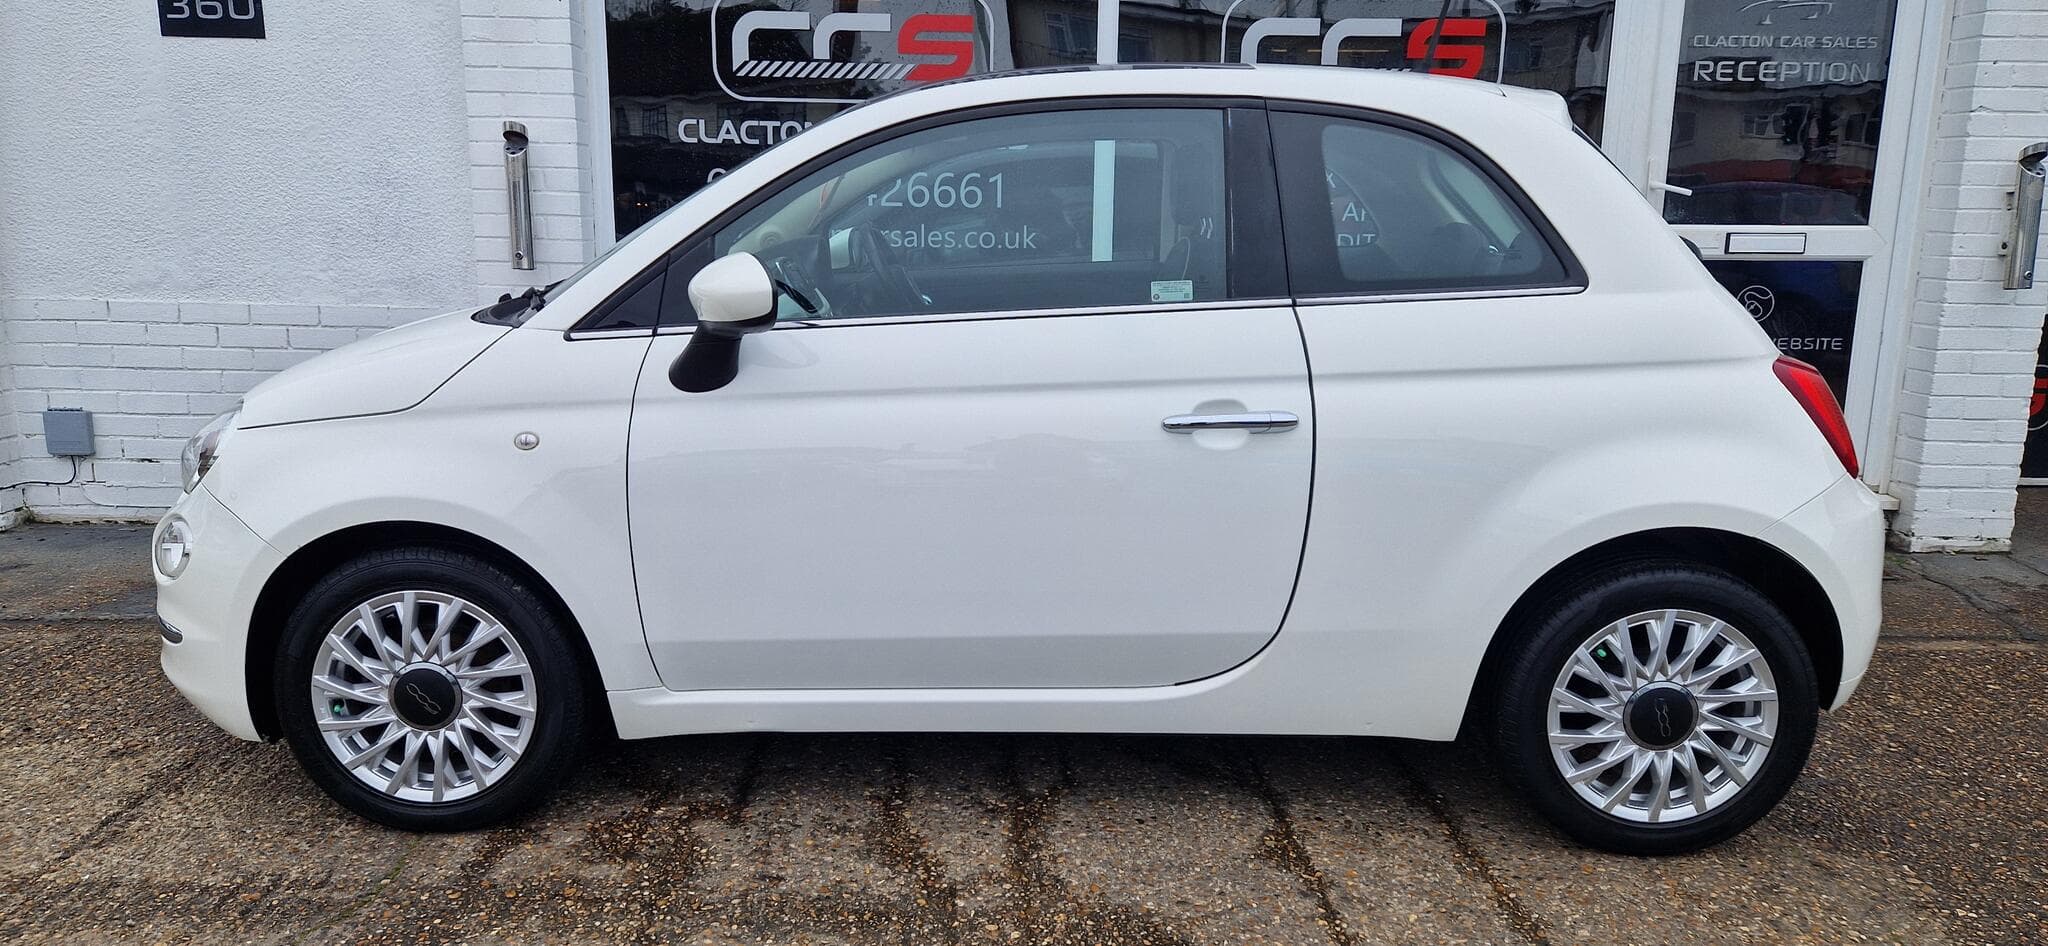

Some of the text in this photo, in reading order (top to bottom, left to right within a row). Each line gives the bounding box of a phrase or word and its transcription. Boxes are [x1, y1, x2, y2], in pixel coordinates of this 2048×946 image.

[731, 10, 974, 81] CCS
[1693, 34, 1879, 49] CLACTON CAR SALES
[1693, 60, 1871, 82] RECEPTION
[677, 118, 813, 145] CLACTO
[1773, 337, 1844, 350] EBSITE
